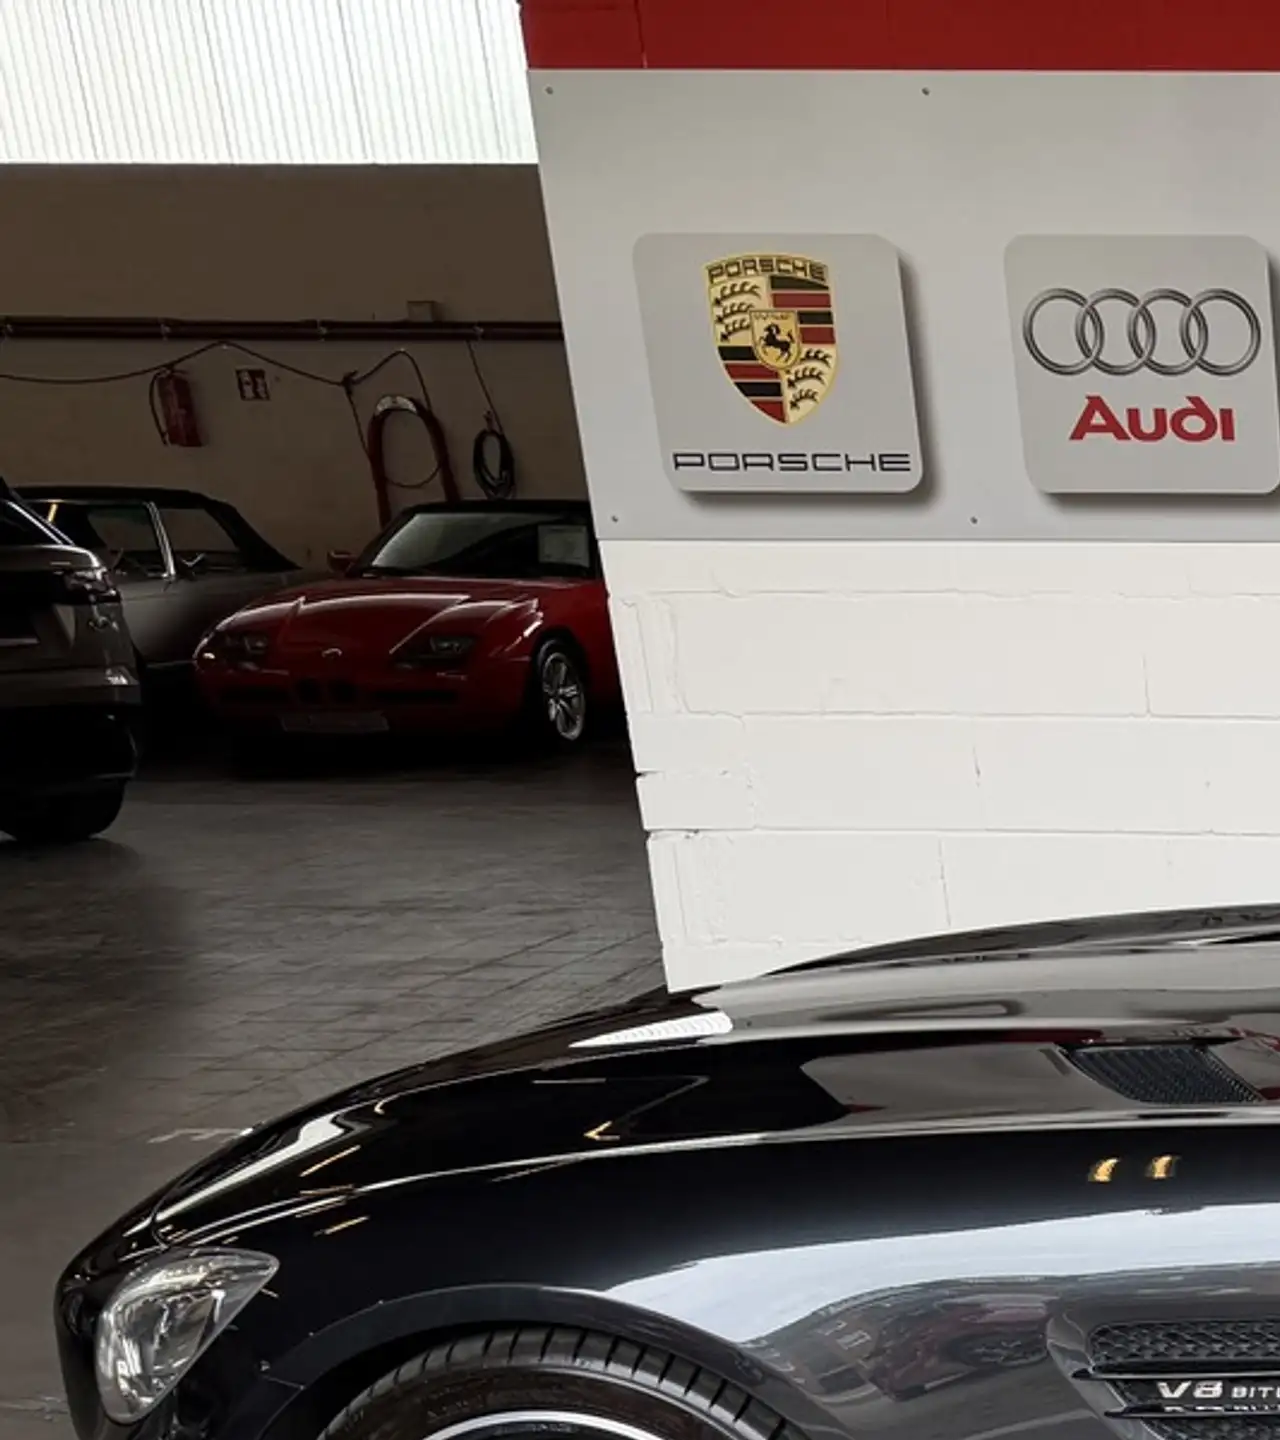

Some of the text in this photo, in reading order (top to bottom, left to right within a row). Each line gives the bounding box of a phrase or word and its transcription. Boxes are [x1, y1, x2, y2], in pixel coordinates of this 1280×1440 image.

[706, 257, 827, 285] PORSCHE
[1069, 396, 1235, 442] Audi
[672, 452, 911, 472] PORSCHE
[1157, 1380, 1223, 1399] V8
